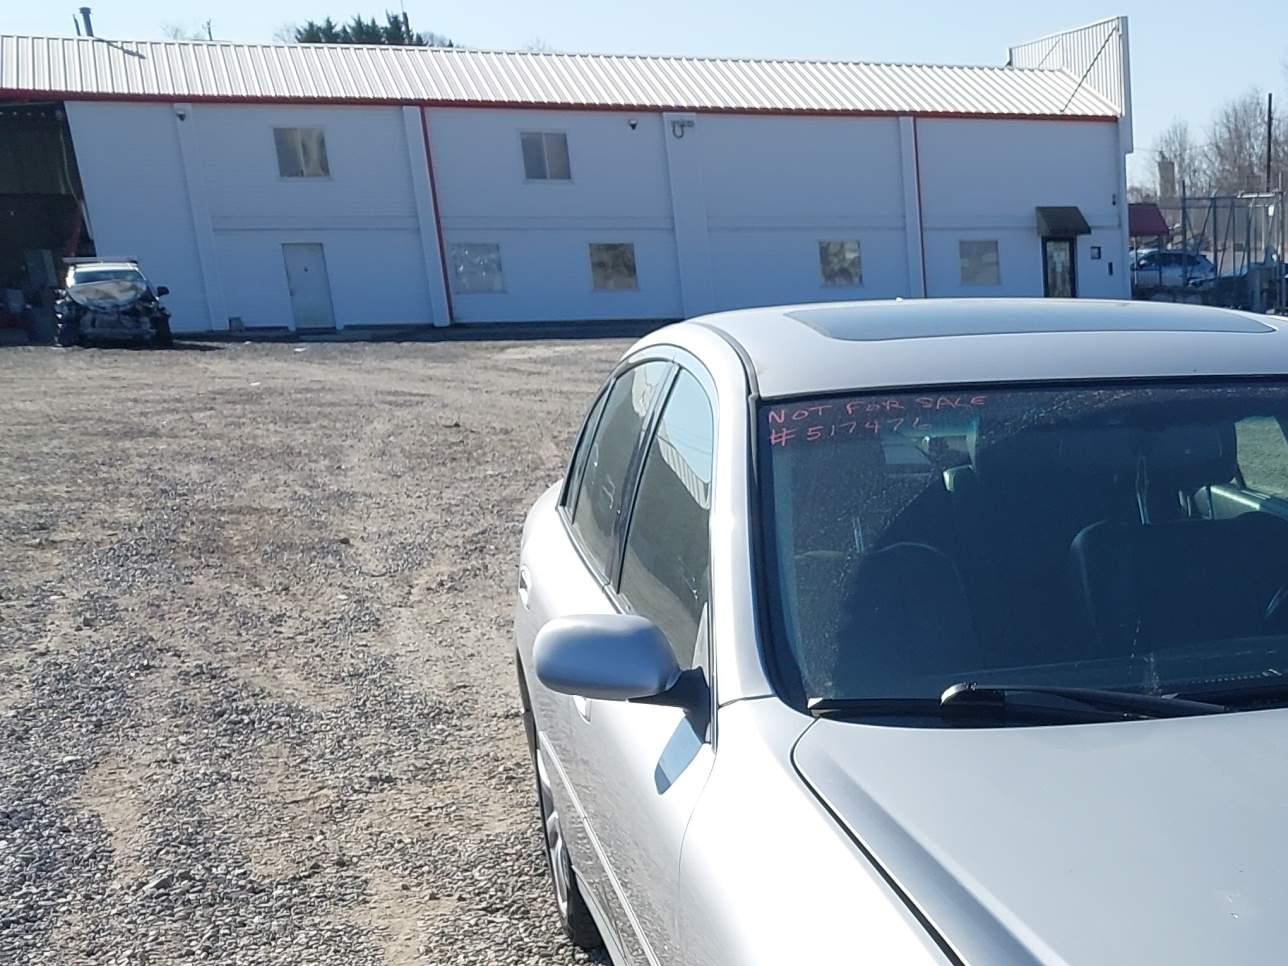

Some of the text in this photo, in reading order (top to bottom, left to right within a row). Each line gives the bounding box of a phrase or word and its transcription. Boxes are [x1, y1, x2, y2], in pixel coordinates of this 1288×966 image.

[768, 395, 988, 423] NOT FOR SALE
